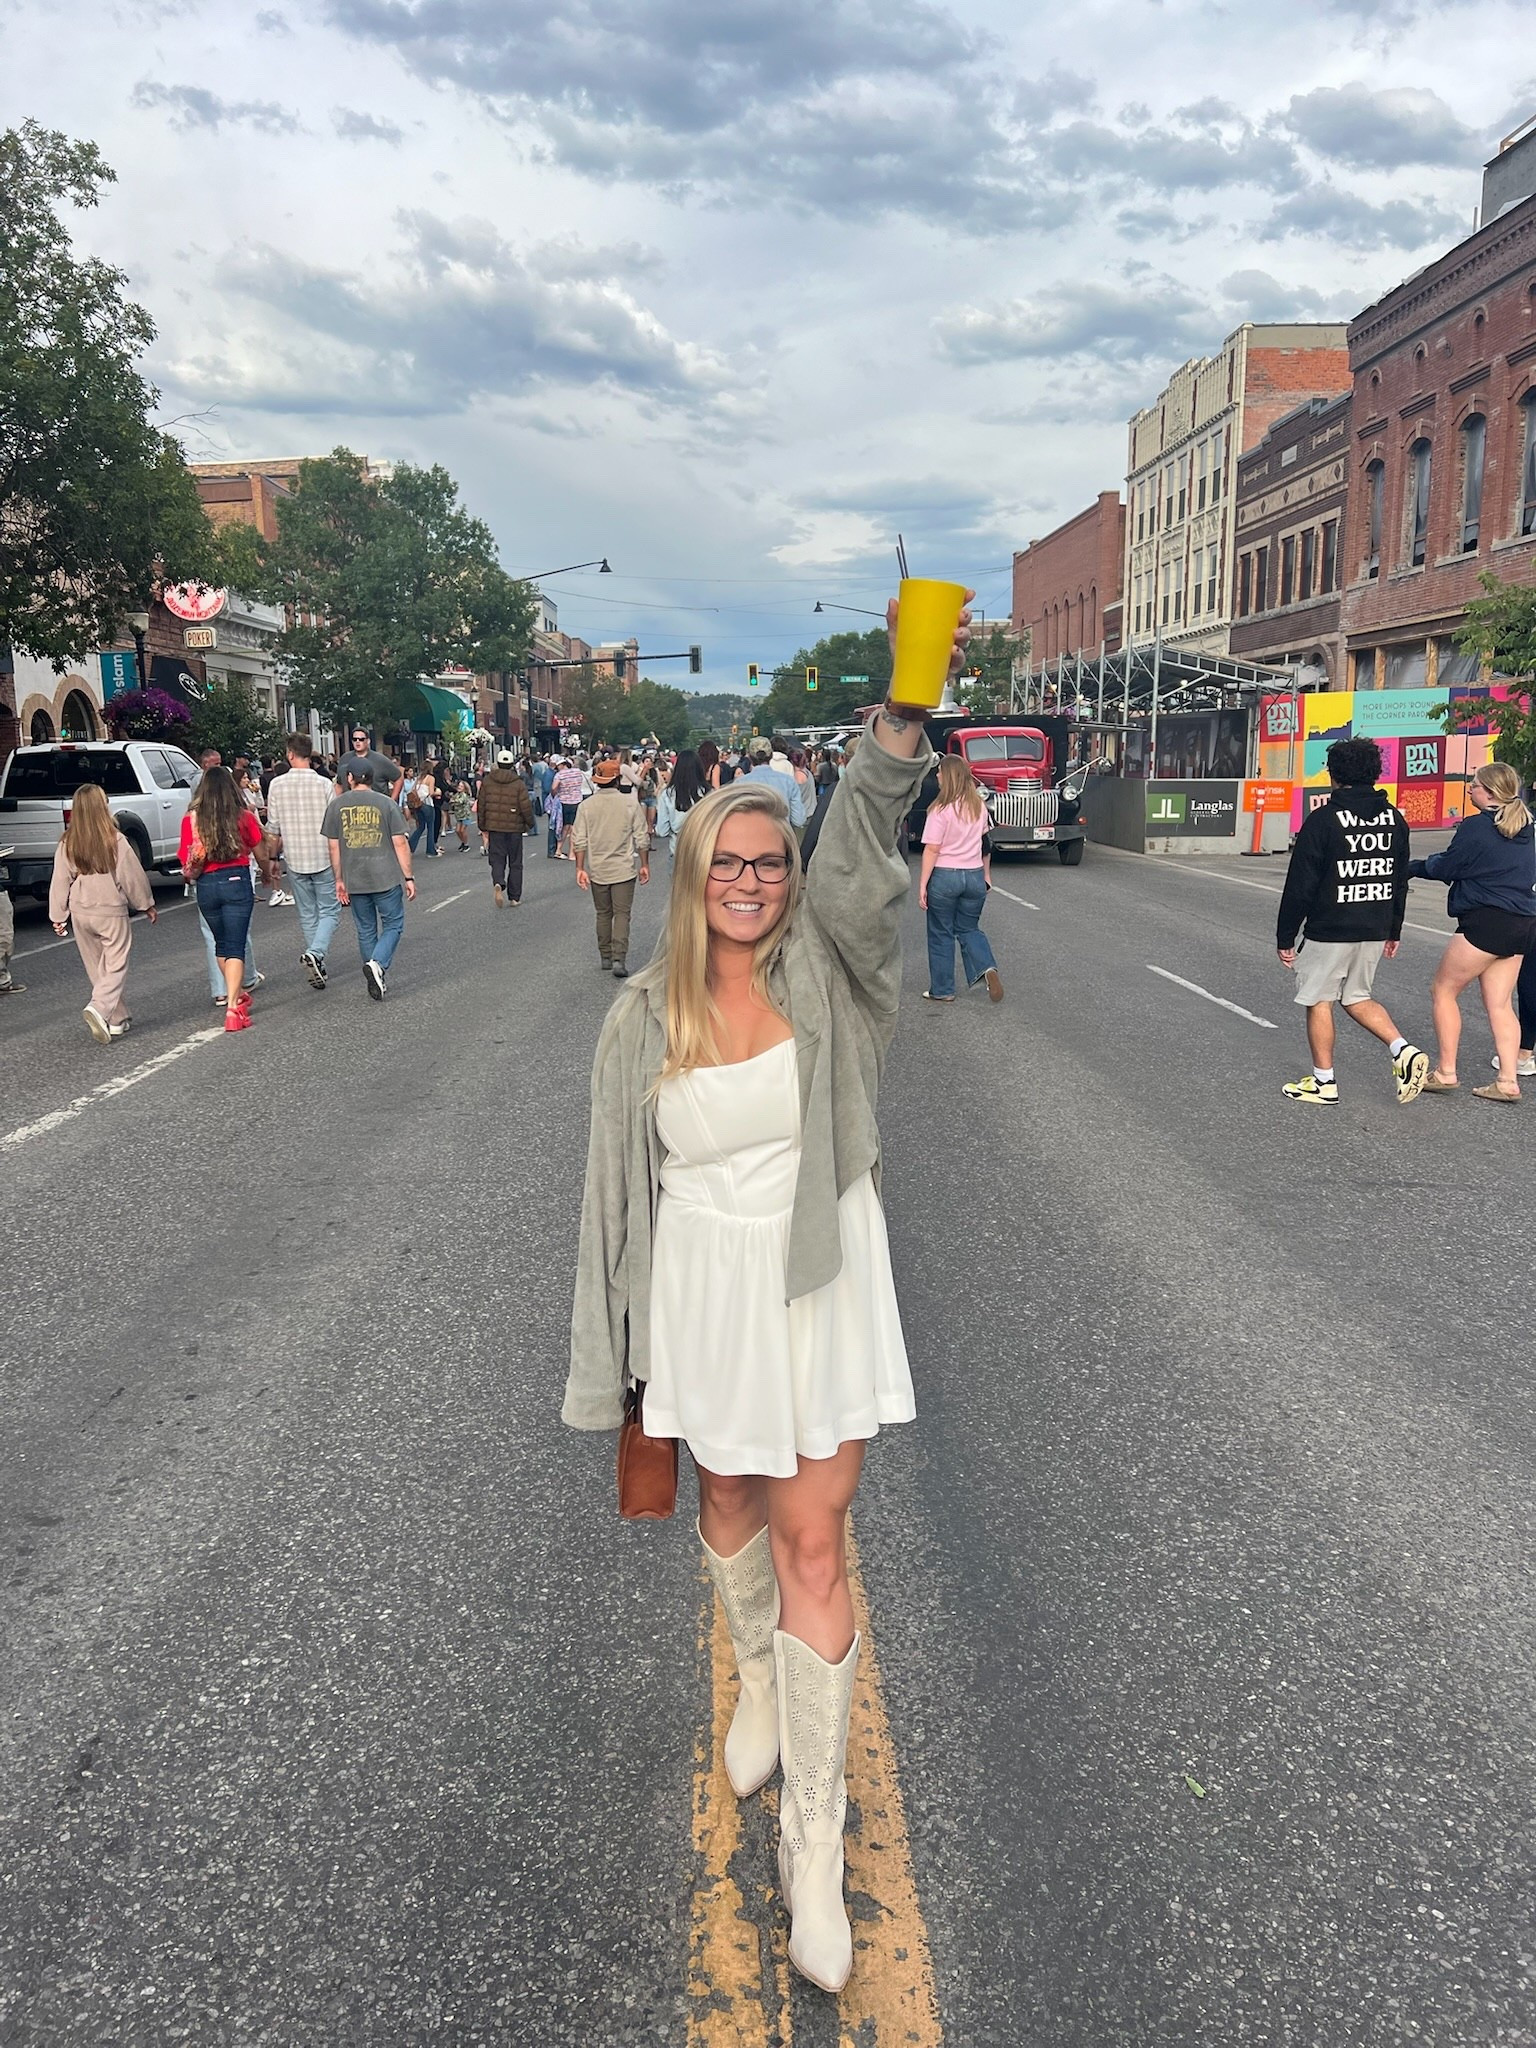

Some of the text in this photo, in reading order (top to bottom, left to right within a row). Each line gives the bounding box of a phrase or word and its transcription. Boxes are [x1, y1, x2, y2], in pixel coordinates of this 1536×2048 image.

[187, 631, 211, 646] POKER
[1376, 711, 1406, 719] CORNER
[1385, 702, 1407, 710] SHOPS
[1405, 742, 1438, 761] DTN
[1406, 758, 1439, 777] BZN
[1191, 800, 1234, 815] Langlas
[1309, 793, 1332, 813] DT
[1345, 832, 1392, 853] YOU
[1336, 857, 1394, 878] WERE
[1336, 882, 1393, 903] HERE
